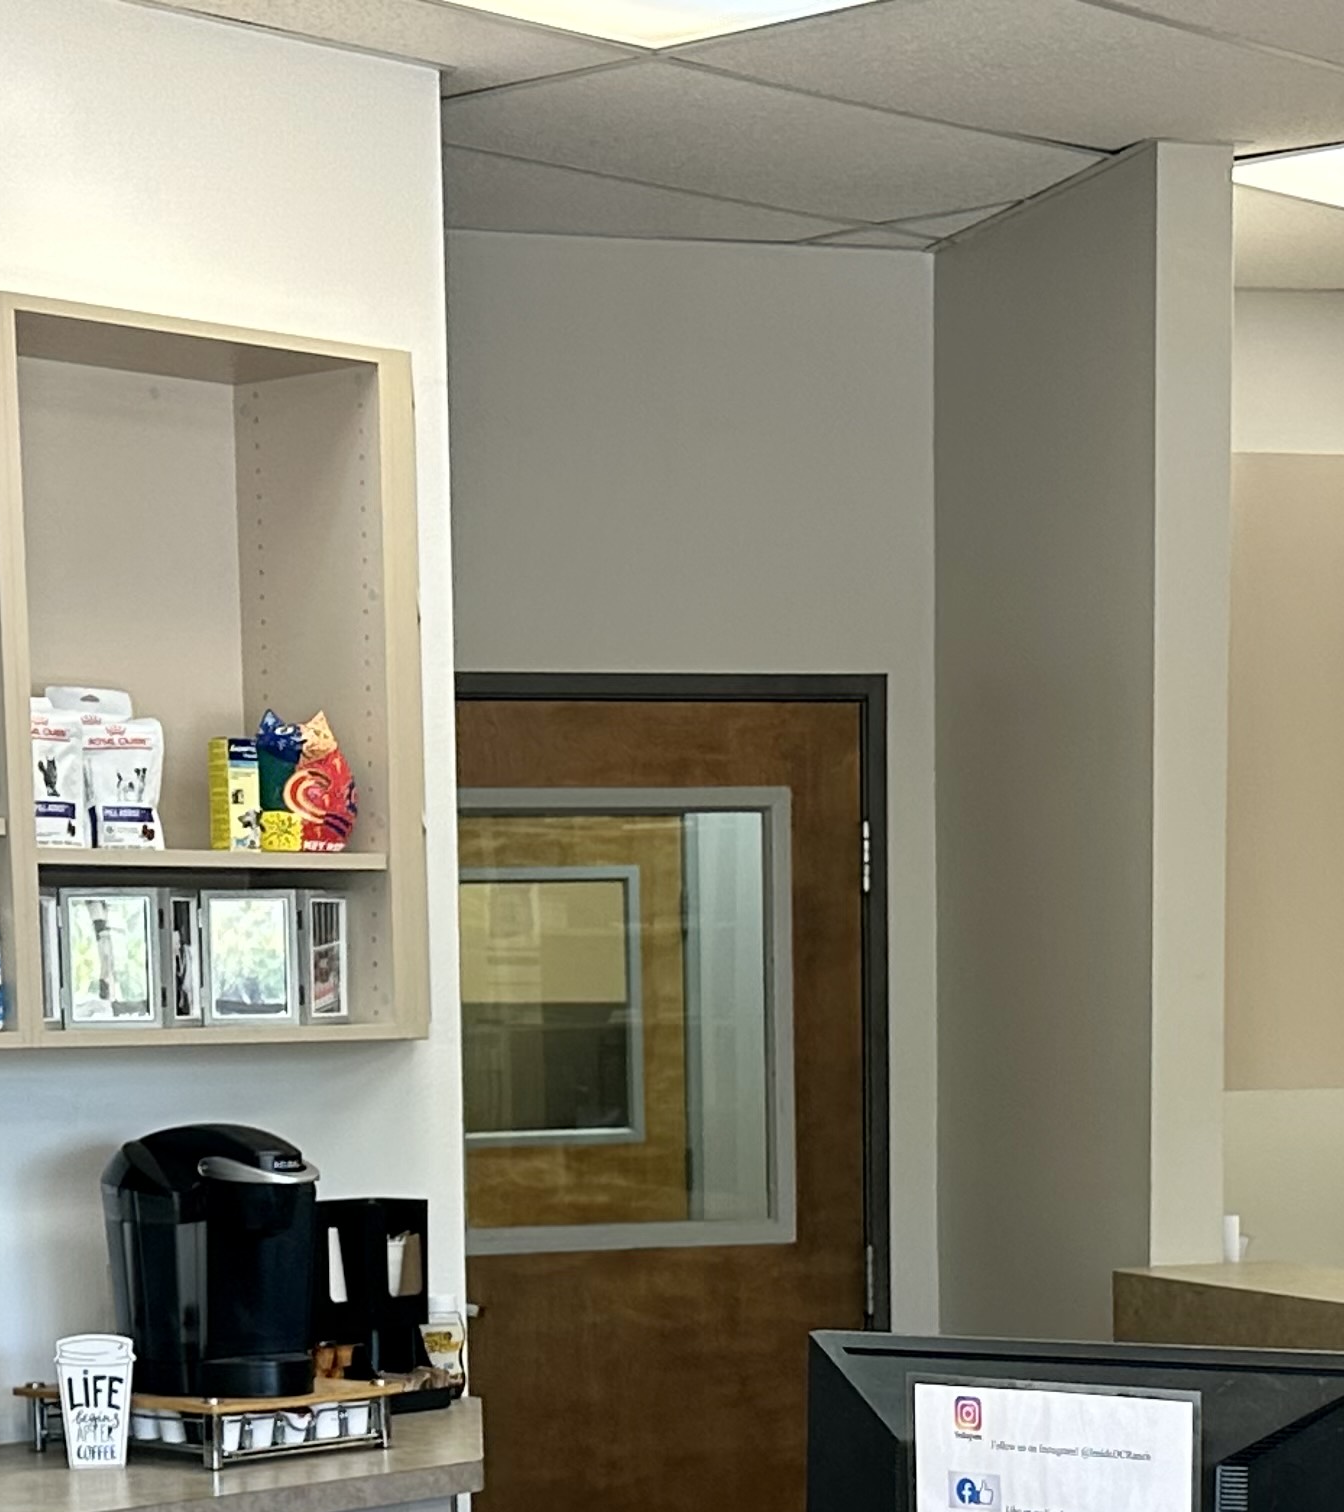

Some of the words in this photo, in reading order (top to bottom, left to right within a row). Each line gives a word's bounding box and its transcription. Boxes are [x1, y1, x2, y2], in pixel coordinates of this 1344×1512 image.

[75, 1409, 120, 1431] begins
[76, 1424, 115, 1442] AFTER
[77, 1444, 117, 1461] COFFEE
[991, 1440, 1015, 1451] Follow
